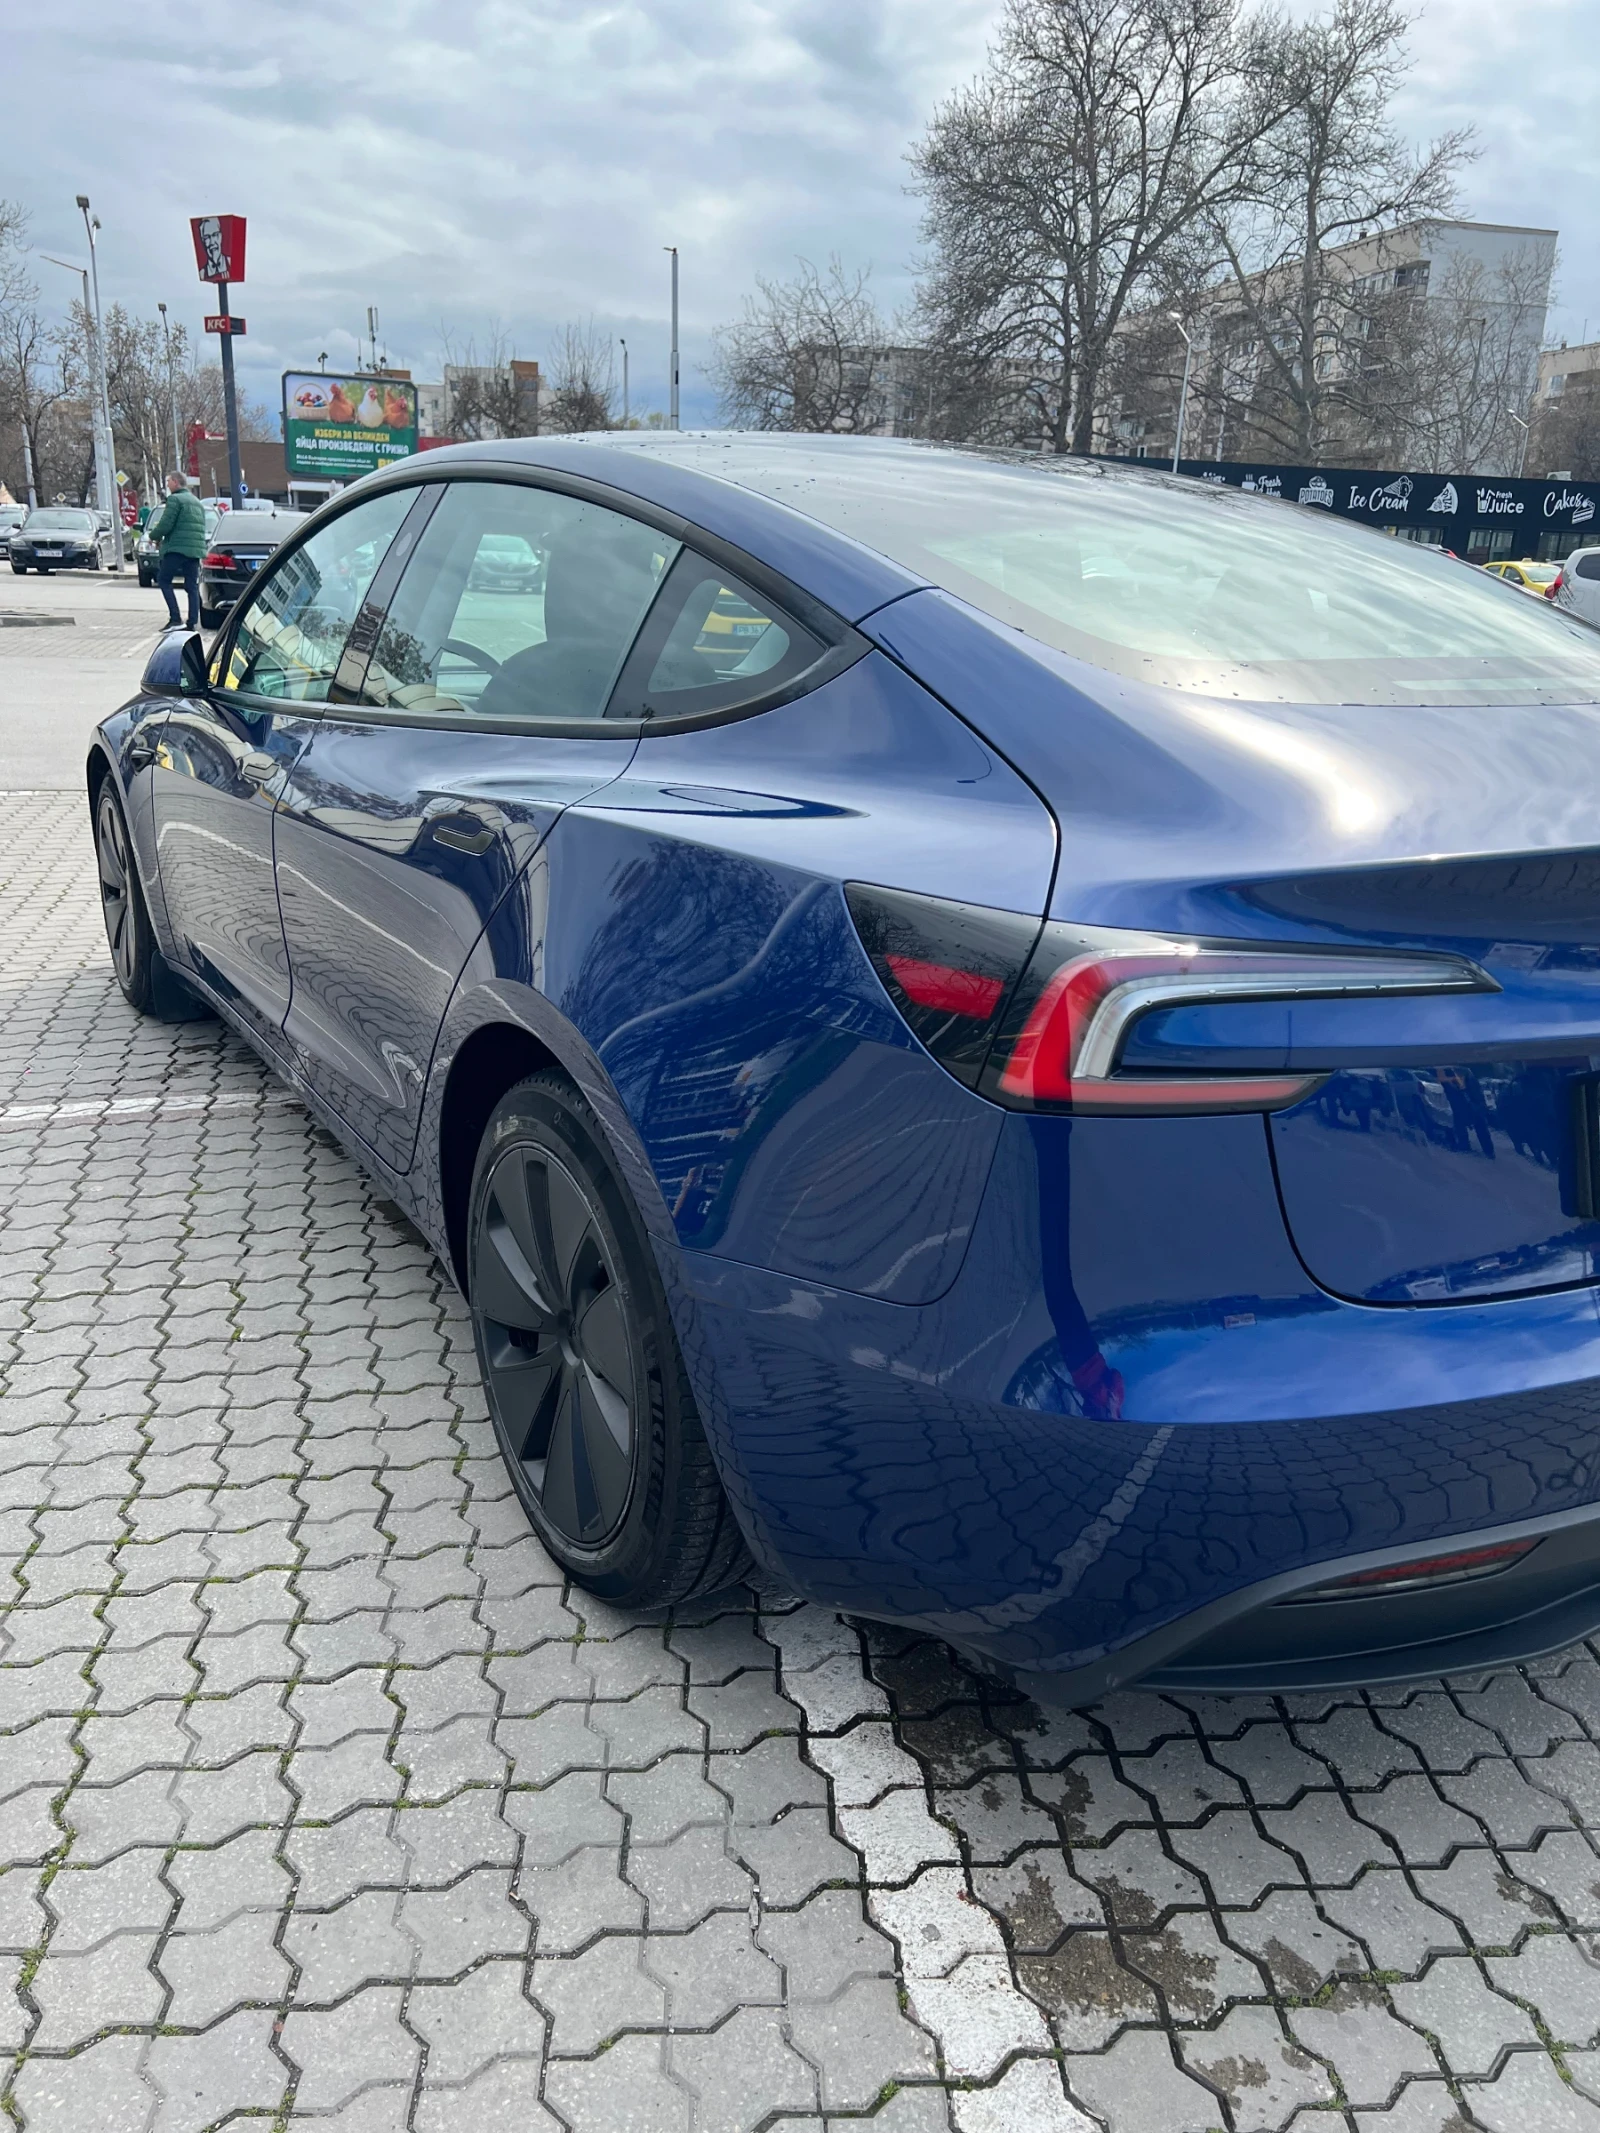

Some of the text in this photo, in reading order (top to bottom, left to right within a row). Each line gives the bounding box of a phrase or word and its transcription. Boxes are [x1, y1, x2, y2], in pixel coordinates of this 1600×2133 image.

[207, 319, 225, 330] KFC
[314, 428, 390, 442] ИЗБЕРИ ЗА ВЕЛИКДЕН
[295, 435, 410, 455] ЯЙЦА ПРОИЗВЕДЕНИ С ГРИЖА
[1258, 475, 1282, 488] Fresh
[1299, 488, 1334, 507] POTATOES
[1347, 485, 1410, 512] Ice Cream
[1441, 488, 1453, 510] PIZZA
[1496, 491, 1512, 499] Fresh
[1488, 499, 1524, 513] Juice
[1543, 489, 1583, 518] Cakes
